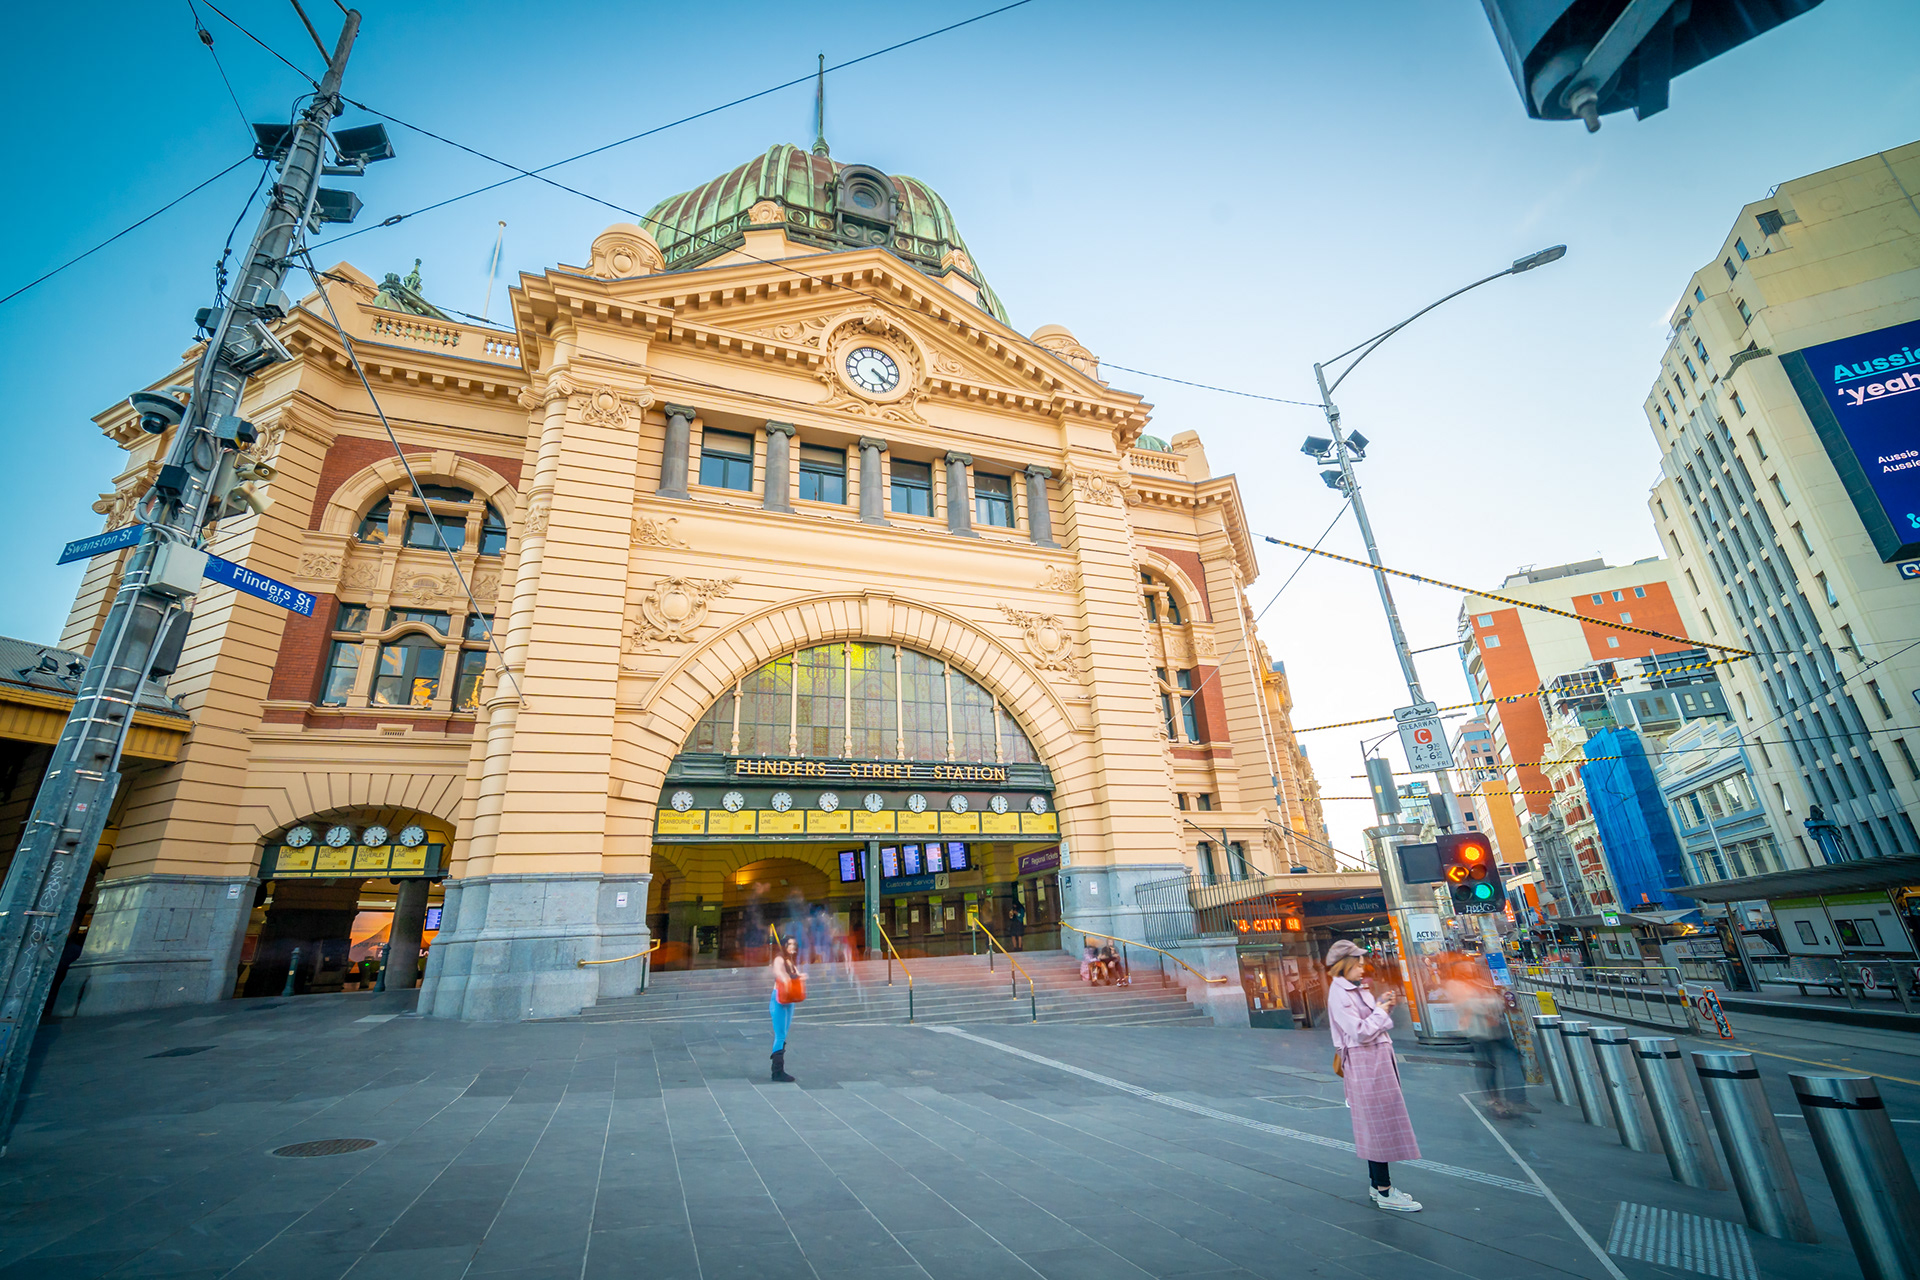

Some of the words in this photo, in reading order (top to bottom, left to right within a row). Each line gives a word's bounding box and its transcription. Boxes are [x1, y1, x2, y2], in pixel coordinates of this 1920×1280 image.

[1878, 450, 1919, 464] Aussie
[65, 535, 118, 556] Swanston
[119, 529, 133, 542] St
[232, 566, 292, 600] Flinders
[296, 593, 312, 609] St
[266, 593, 284, 605] 207
[292, 603, 309, 615] 273
[1400, 719, 1438, 731] CLEARWAY
[1417, 730, 1429, 743] C
[736, 760, 827, 776] FLINDERS
[850, 763, 914, 779] STREET
[933, 765, 1006, 781] STATION
